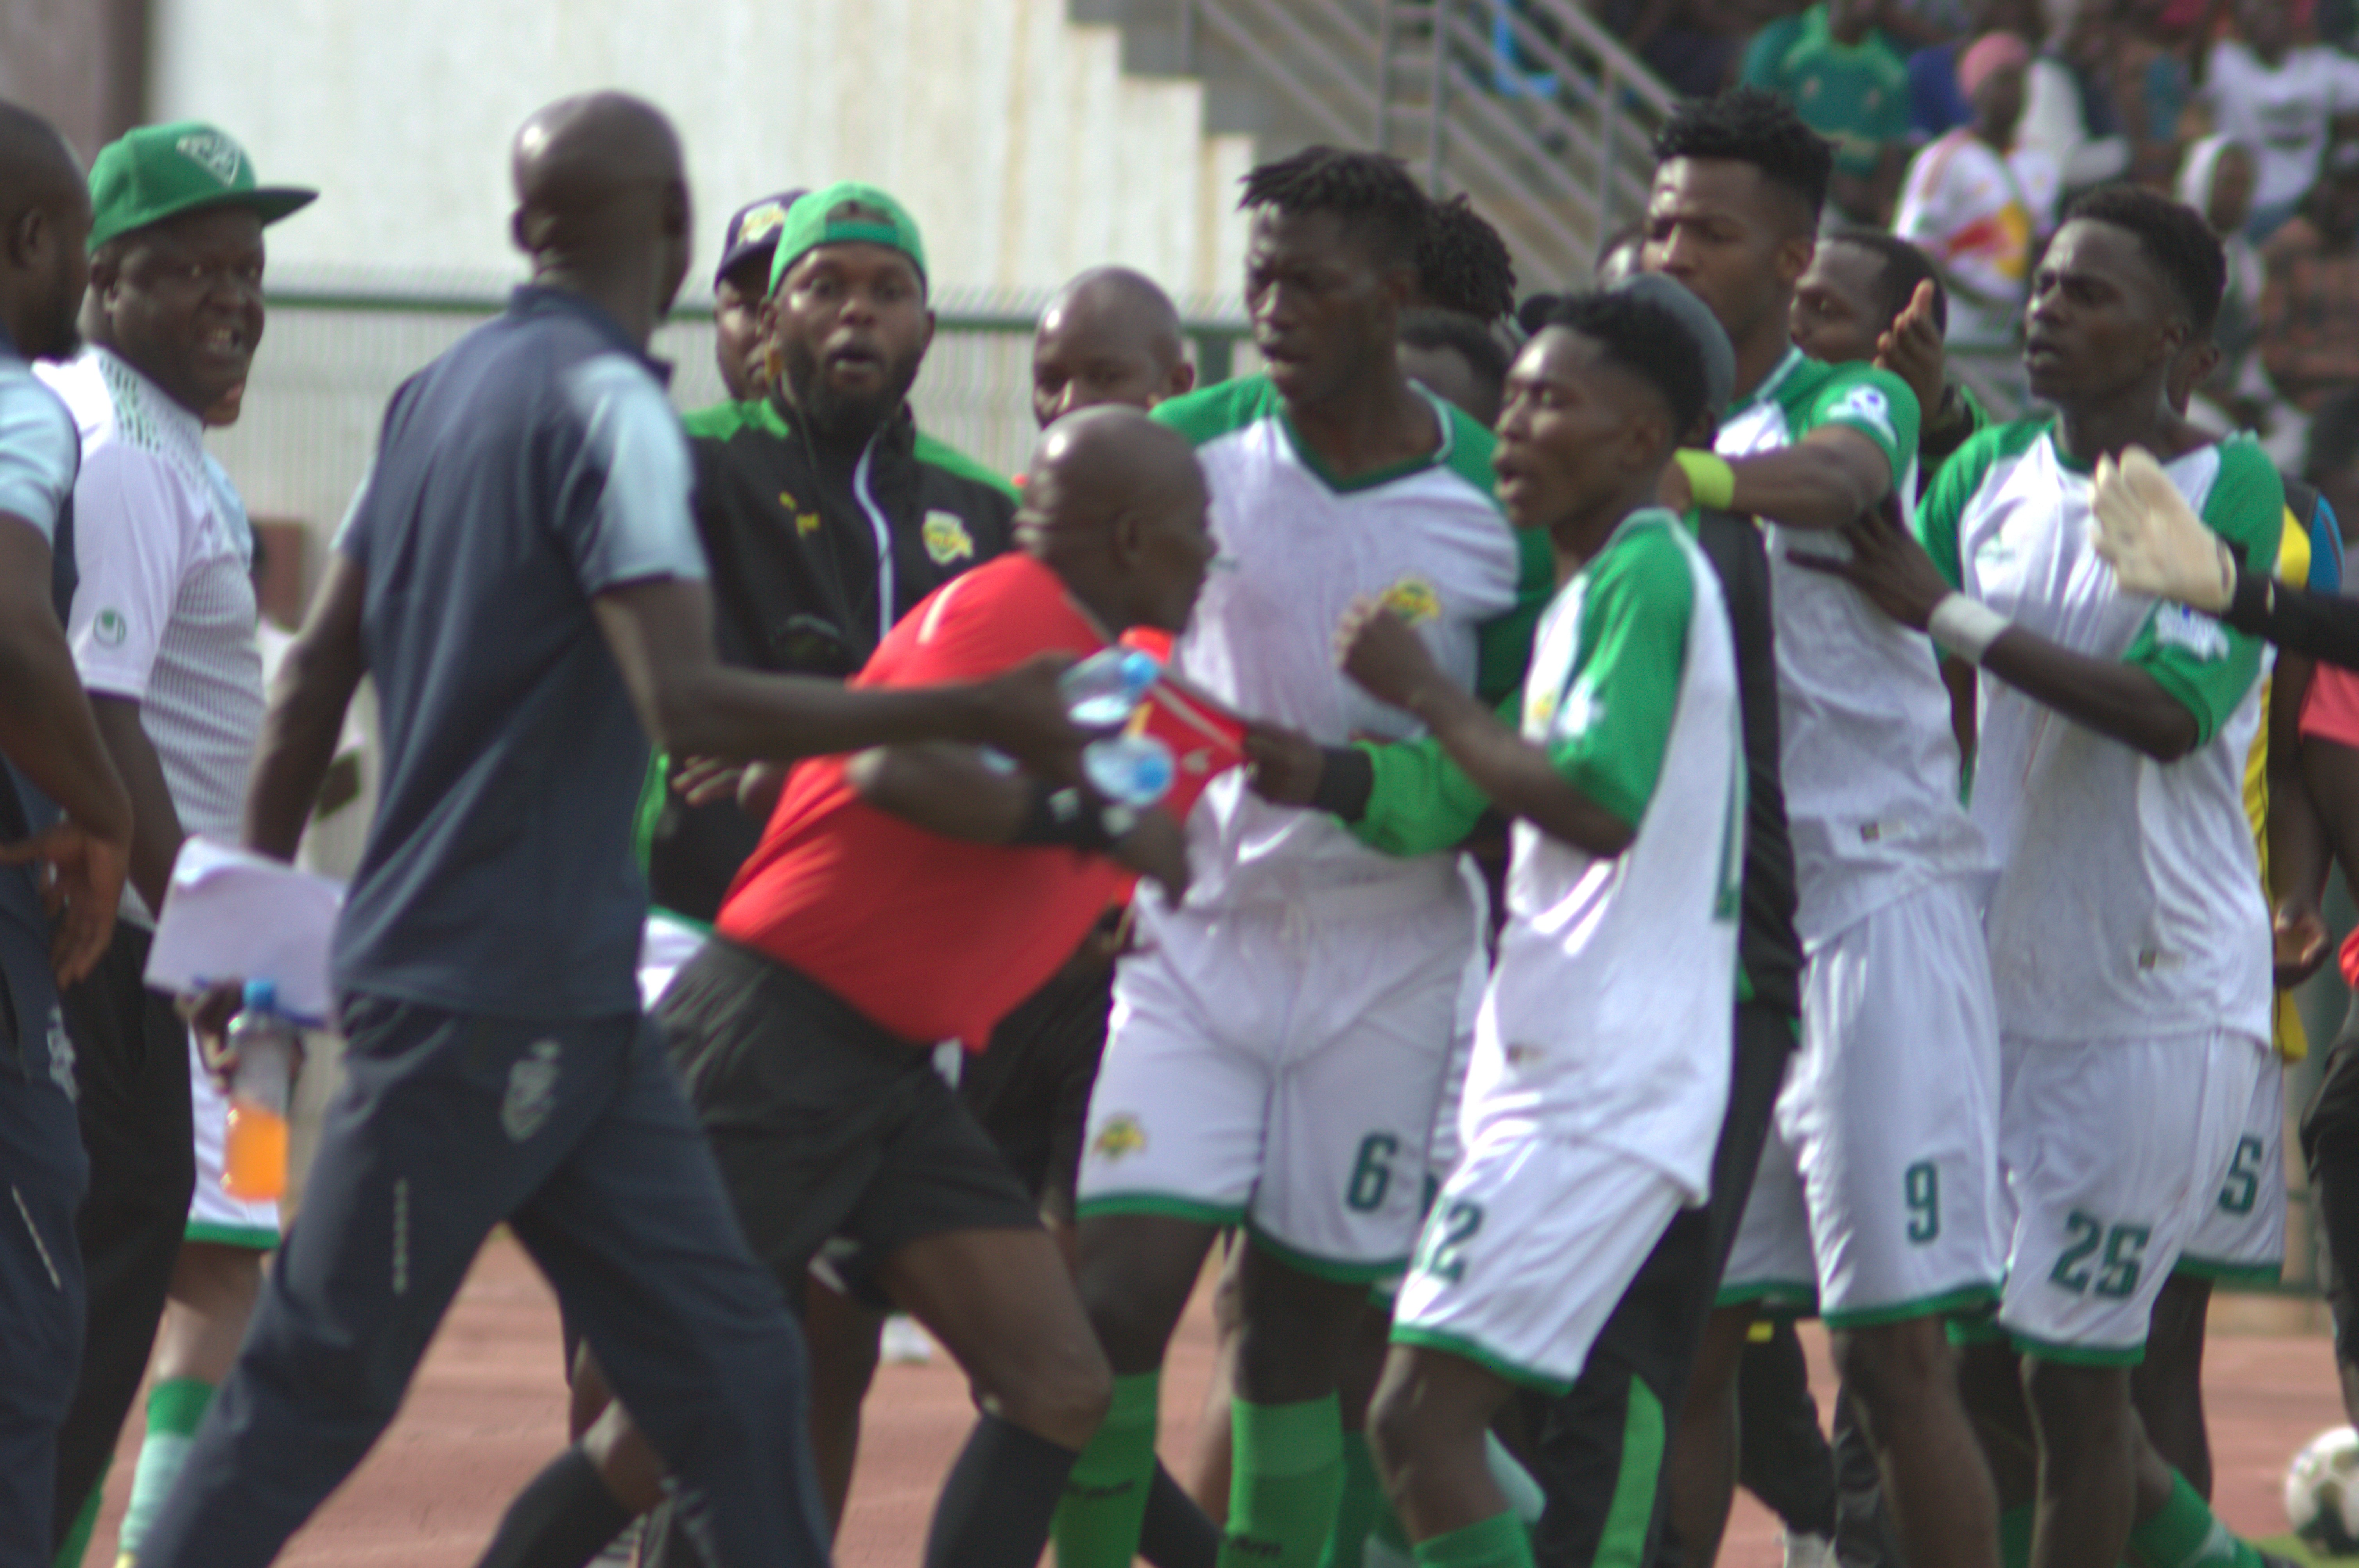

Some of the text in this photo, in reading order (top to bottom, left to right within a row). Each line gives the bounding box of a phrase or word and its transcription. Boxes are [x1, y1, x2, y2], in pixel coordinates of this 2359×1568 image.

[1346, 1132, 1400, 1212] 6
[1904, 1156, 1939, 1244] 9
[2217, 1135, 2263, 1216] 5
[2048, 1210, 2151, 1300] 25
